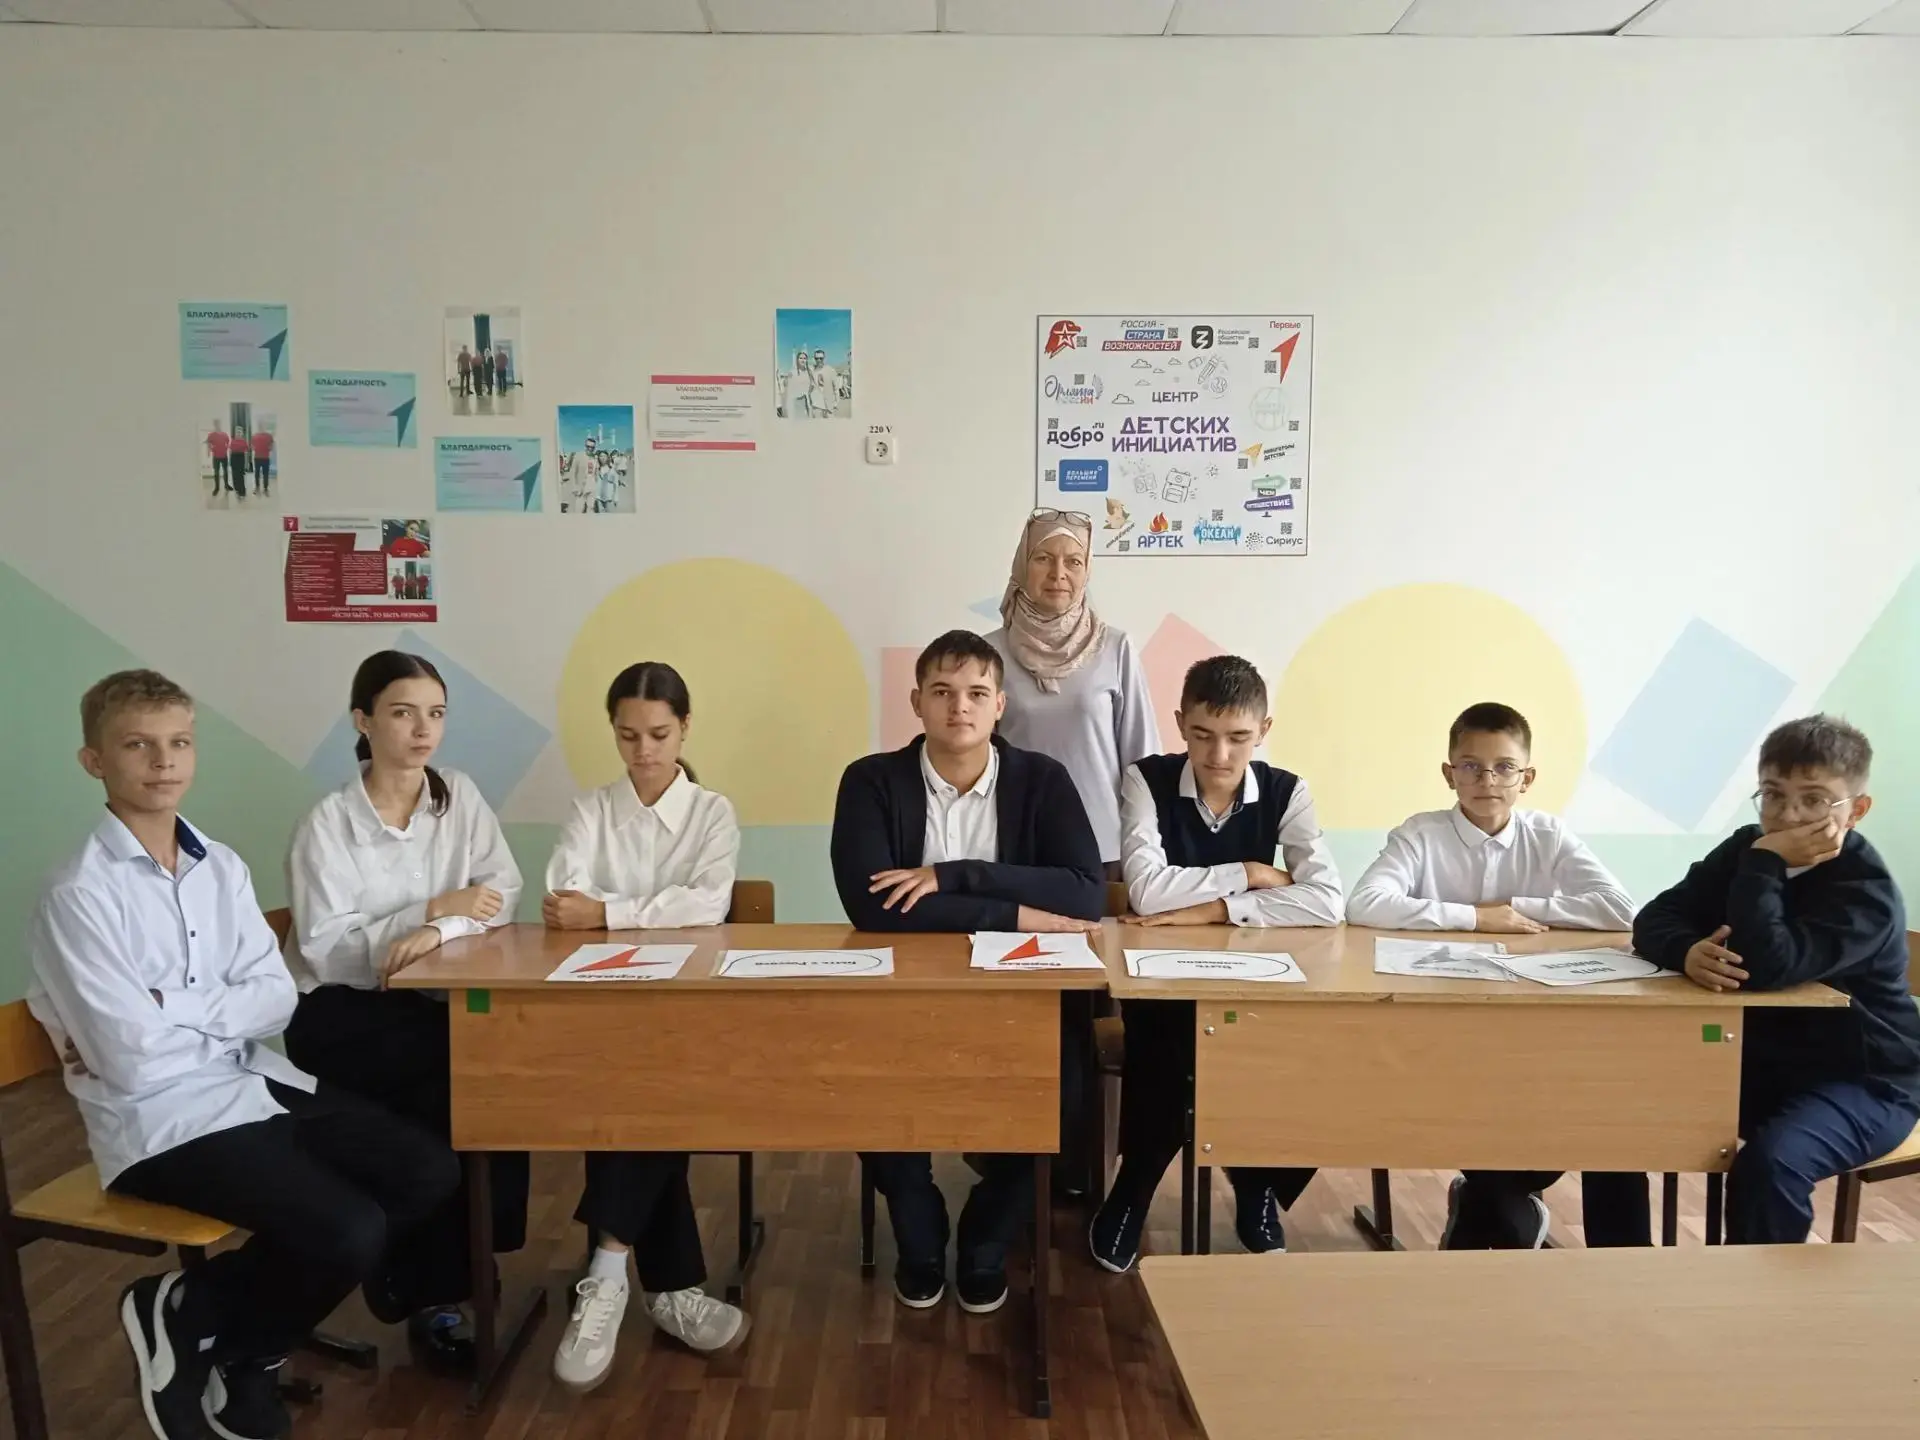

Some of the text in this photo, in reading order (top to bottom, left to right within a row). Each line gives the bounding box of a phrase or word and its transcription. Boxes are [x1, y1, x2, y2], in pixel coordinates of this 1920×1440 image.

[186, 311, 259, 319] БЛАГОДАРНОСТЬ
[1120, 320, 1157, 328] РОССИЯ
[1269, 320, 1301, 330] Первые
[1126, 331, 1162, 340] СТРАНА
[1104, 341, 1178, 350] ВОЗМОЖНОСТЕЙ
[315, 378, 387, 387] БЛАГОДАРНОСТЬ
[1152, 391, 1198, 403] ЦЕНТР
[869, 425, 893, 433] 220 V
[1120, 416, 1230, 435] ДЕТСКИХ
[1047, 426, 1104, 447] добро
[1111, 437, 1237, 453] ИНИЦИАТИВ
[1201, 528, 1234, 539] ОКЕАН
[1137, 535, 1184, 548] АРТЕК
[1266, 536, 1304, 546] Сириус
